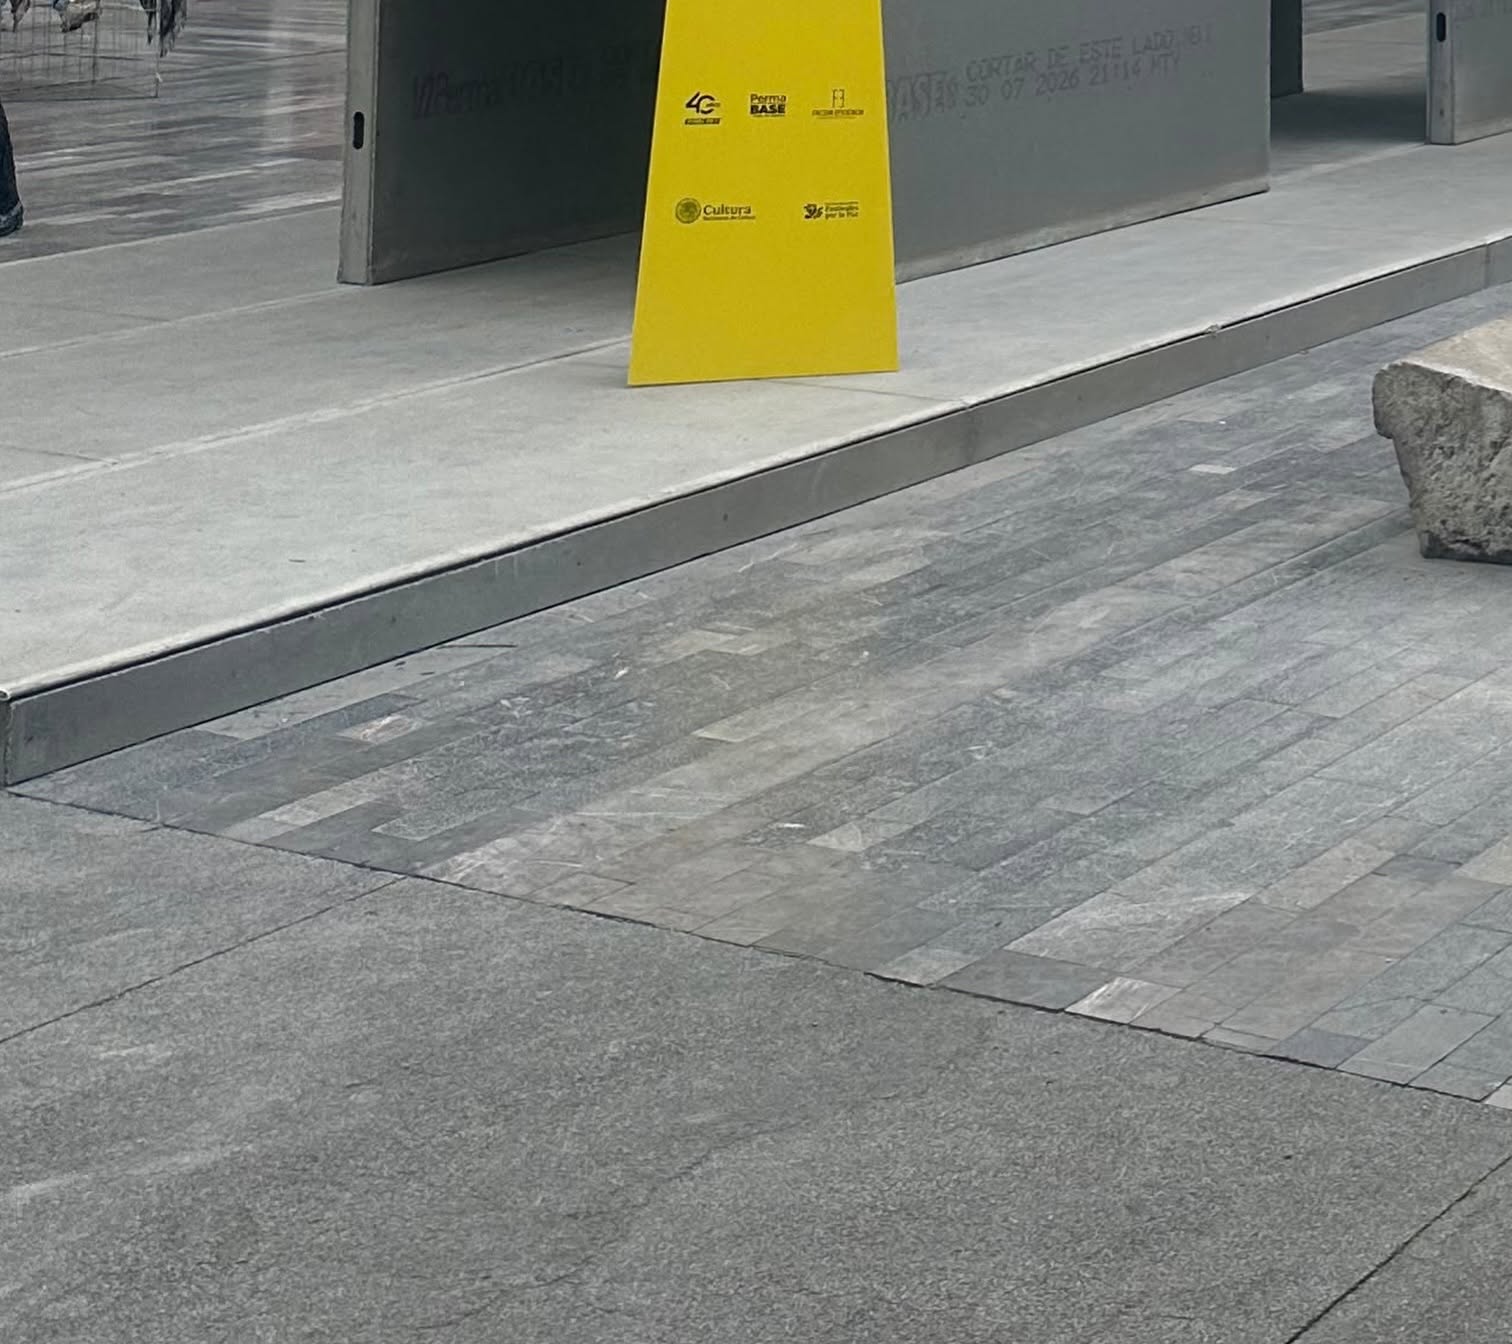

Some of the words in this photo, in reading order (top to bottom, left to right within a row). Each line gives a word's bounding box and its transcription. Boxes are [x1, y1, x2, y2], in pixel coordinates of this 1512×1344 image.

[1079, 35, 1124, 65] ESTE
[1001, 76, 1026, 102] 07
[1034, 66, 1081, 98] 2026
[750, 93, 787, 105] Perma
[750, 104, 786, 115] BASE
[703, 203, 752, 216] Cultura
